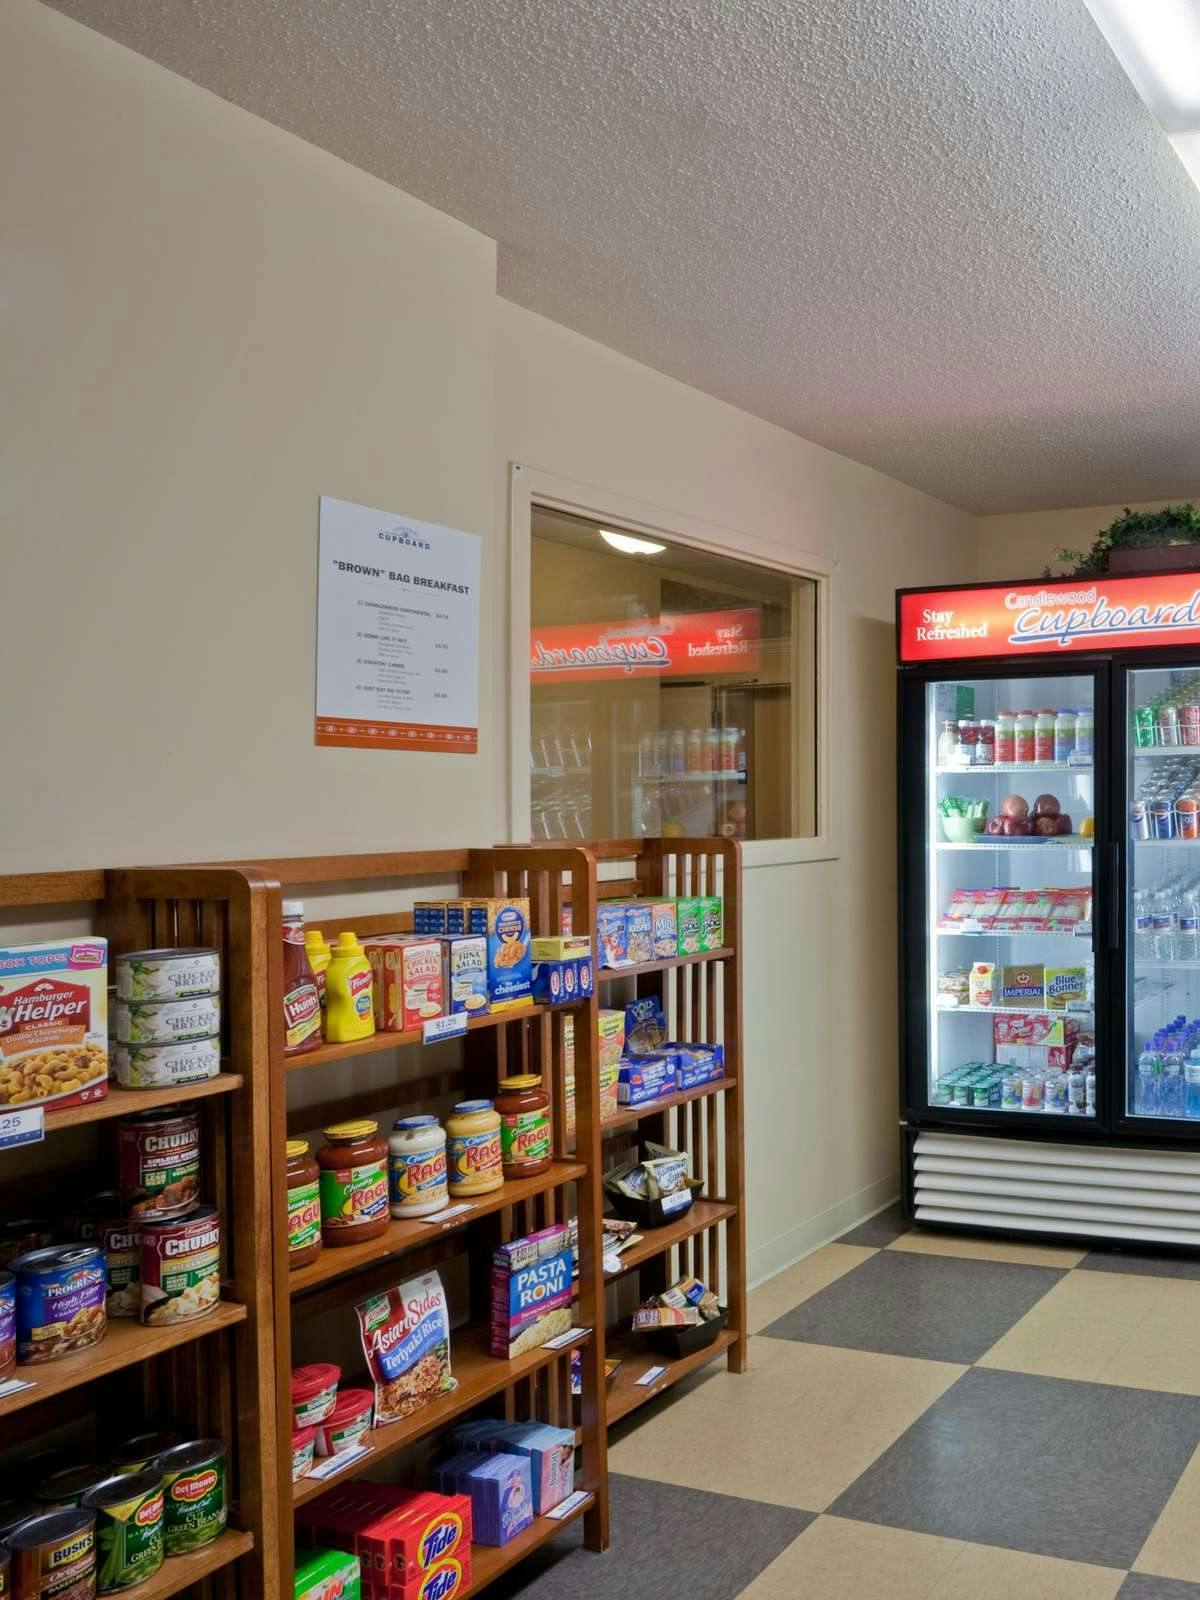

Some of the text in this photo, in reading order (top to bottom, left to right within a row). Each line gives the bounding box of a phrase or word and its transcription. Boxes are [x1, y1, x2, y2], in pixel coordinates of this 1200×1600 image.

[378, 532, 430, 550] CUPBOARD
[389, 570, 410, 584] BAG
[413, 575, 470, 595] BREAKFAST
[1005, 587, 1097, 610] Candlewood
[922, 608, 954, 625] Stay
[1014, 590, 1200, 645] Cupboard
[916, 623, 988, 642] Refreshed
[456, 960, 483, 970] SALAD
[458, 951, 480, 961] TUNA
[408, 966, 437, 978] SALAD
[1055, 975, 1077, 986] Blue
[13, 990, 74, 1005] Hamburger
[495, 981, 531, 994] cheesiest
[1004, 987, 1042, 996] IMPERIAL
[1049, 981, 1084, 995] Bonnet
[15, 999, 88, 1023] Helper
[145, 1128, 199, 1152] CHUNKY
[166, 1229, 219, 1256] CHUNKY
[517, 1258, 566, 1291] PASTA
[520, 1276, 563, 1307] RONI
[369, 1288, 441, 1358] Asian Sides
[382, 1318, 442, 1371] Teriyaki Rice
[175, 1475, 216, 1494] Del Monte
[54, 1533, 93, 1564] BUSH'S
[423, 1524, 458, 1569] Tide
[423, 1570, 458, 1600] Tide
